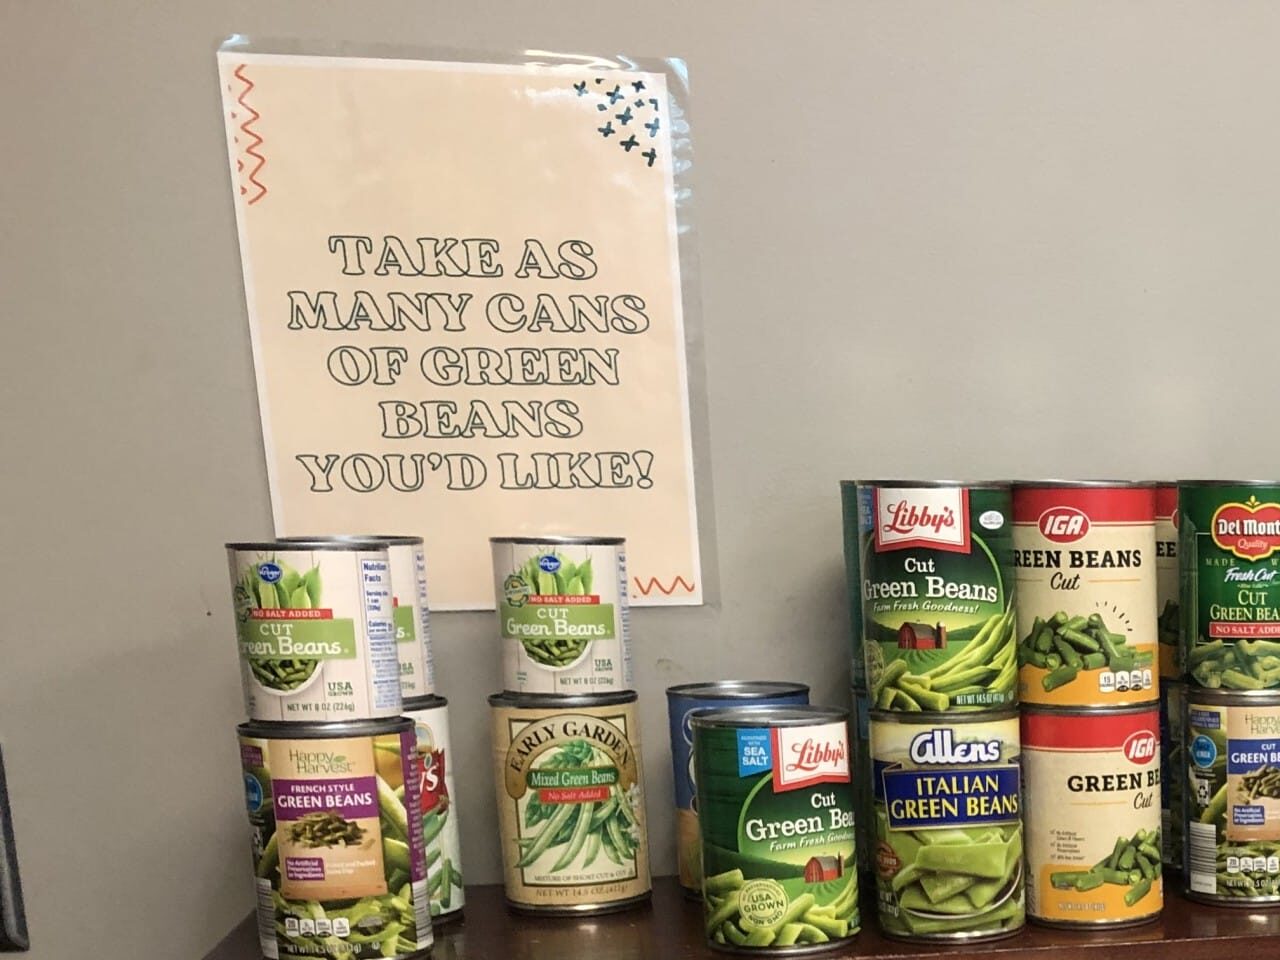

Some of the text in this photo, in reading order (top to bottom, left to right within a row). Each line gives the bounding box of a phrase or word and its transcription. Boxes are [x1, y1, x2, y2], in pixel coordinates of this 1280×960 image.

[329, 235, 598, 281] TAKE AS
[287, 291, 651, 335] MANY CANS
[327, 345, 622, 387] OF GREEN
[378, 399, 585, 440] BEANS
[296, 450, 655, 493] YOU'D LIKE!
[883, 500, 955, 533] Libby's
[1044, 515, 1083, 535] IGA
[1217, 519, 1241, 535] Del
[1237, 538, 1269, 550] Quality
[904, 557, 935, 573] Cut
[1069, 549, 1142, 569] BEANS
[1206, 558, 1236, 567] MADE
[1050, 572, 1080, 591] Cut
[1224, 566, 1280, 583] Fresh Cut
[864, 576, 998, 604] Green Beans
[1238, 590, 1268, 606] CUT
[536, 608, 569, 619] CUT
[893, 601, 919, 612] Fresh
[922, 600, 979, 615] Goodness!
[1210, 604, 1254, 621] GREEN
[259, 623, 293, 635] CUT
[506, 617, 553, 636] Green
[1215, 625, 1231, 634] NO
[1232, 625, 1257, 634] SALT
[1244, 714, 1280, 727] Happy
[510, 720, 630, 773] EARLY GARDEN
[744, 747, 766, 757] SEA
[1128, 737, 1154, 759] IGA
[1261, 743, 1276, 751] CUT
[288, 748, 335, 764] Happy
[742, 756, 769, 766] SALT
[785, 738, 845, 772] Libby's
[1231, 752, 1268, 764] GREEN
[296, 760, 353, 774] Harvest
[530, 770, 616, 786] Mixed Green Beans
[916, 775, 999, 795] ITALIAN
[1067, 772, 1142, 792] GREEN
[290, 783, 355, 793] FRENCH STYLE
[277, 793, 373, 808] GREEN BEANS
[811, 792, 835, 808] Cut
[891, 795, 1019, 819] GREEN BEANS
[745, 815, 825, 842] Green
[770, 836, 825, 852] Farm Fresh
[751, 892, 772, 903] USA
[743, 900, 785, 914] GROWN
